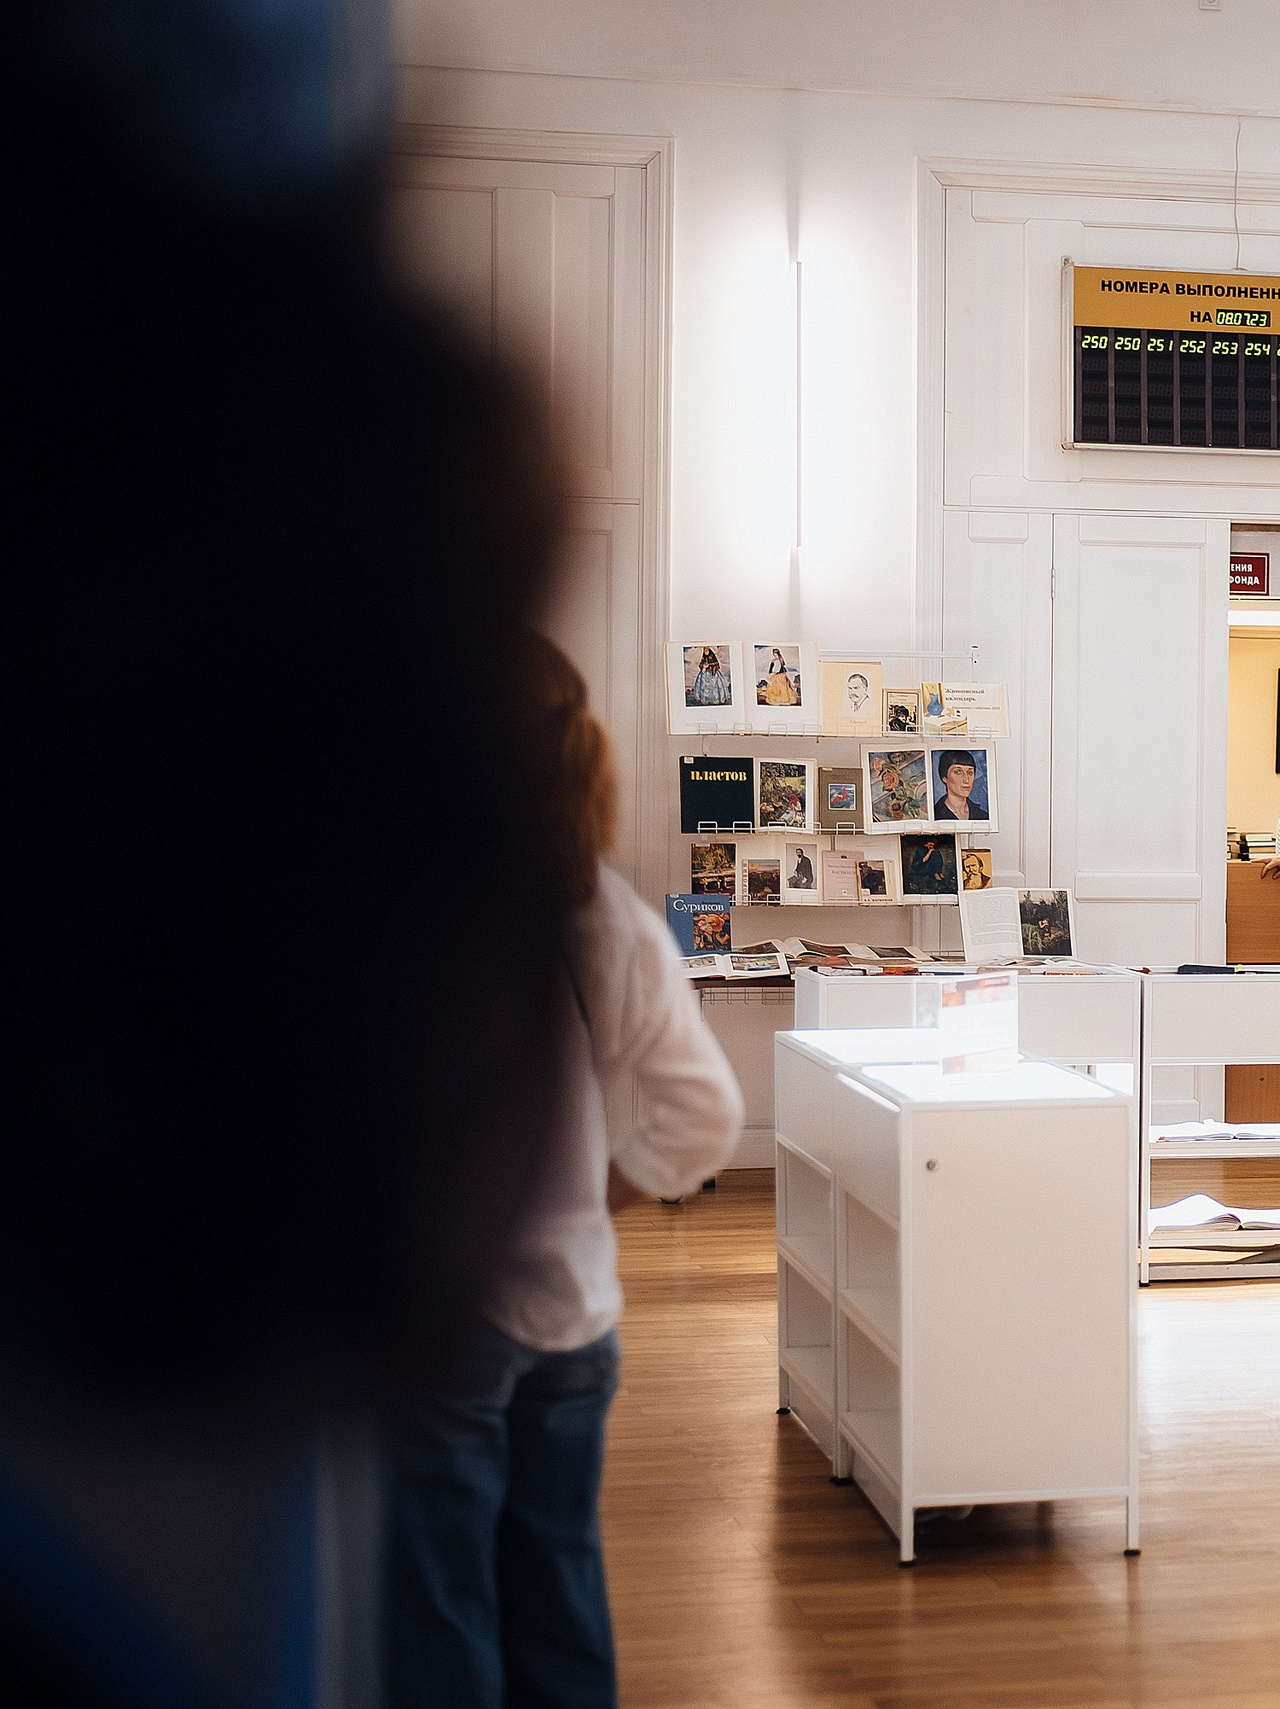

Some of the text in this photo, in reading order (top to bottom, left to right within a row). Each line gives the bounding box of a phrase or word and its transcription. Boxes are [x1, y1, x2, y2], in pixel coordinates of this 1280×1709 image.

[1101, 280, 1170, 295] НОМЕРА
[1190, 311, 1213, 323] НА
[1081, 335, 1108, 349] 250
[1114, 337, 1141, 351] 250
[1147, 338, 1174, 352] 251
[1179, 340, 1206, 354] 252
[1212, 341, 1239, 355] 253
[1244, 342, 1271, 356] 254
[673, 899, 725, 913] Суриков
